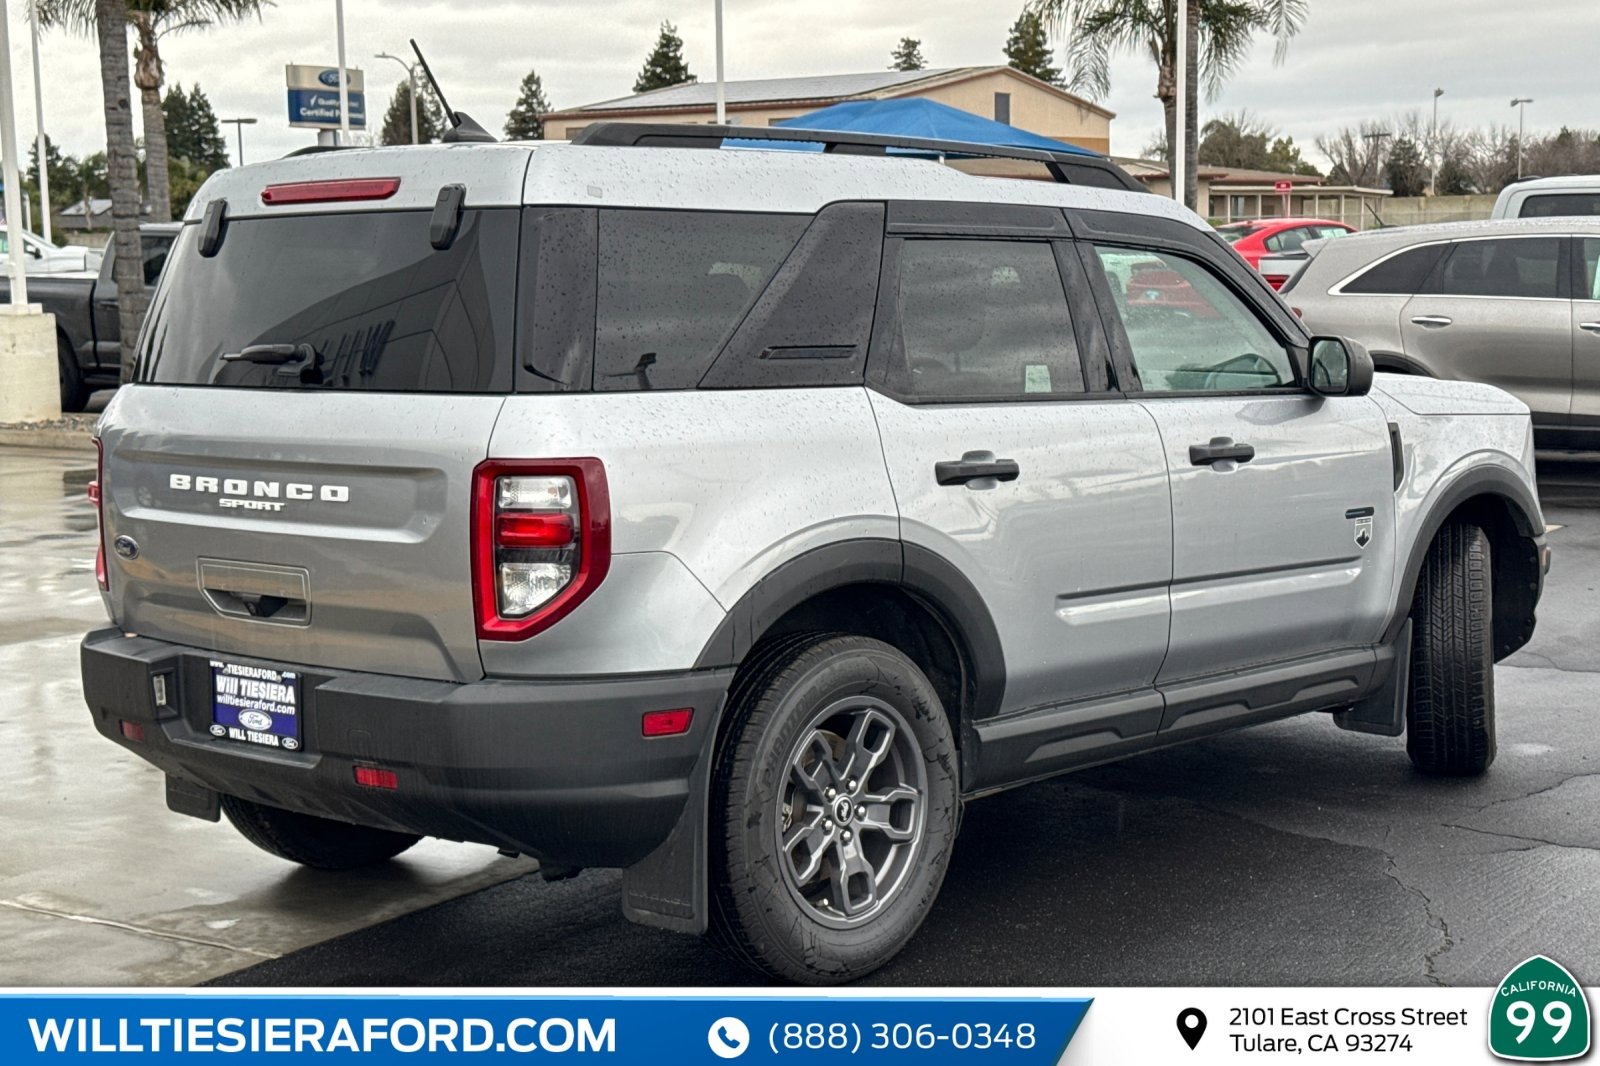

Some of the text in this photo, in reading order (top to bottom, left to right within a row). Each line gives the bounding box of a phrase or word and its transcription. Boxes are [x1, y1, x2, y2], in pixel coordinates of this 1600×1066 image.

[169, 473, 349, 502] BRONCO
[218, 498, 285, 511] SPORT
[227, 664, 277, 680] TIESIERAFORD
[240, 679, 295, 704] TIESIERA
[216, 694, 295, 715] willtiesieraford.com
[229, 727, 279, 747] WILL TIESIERA
